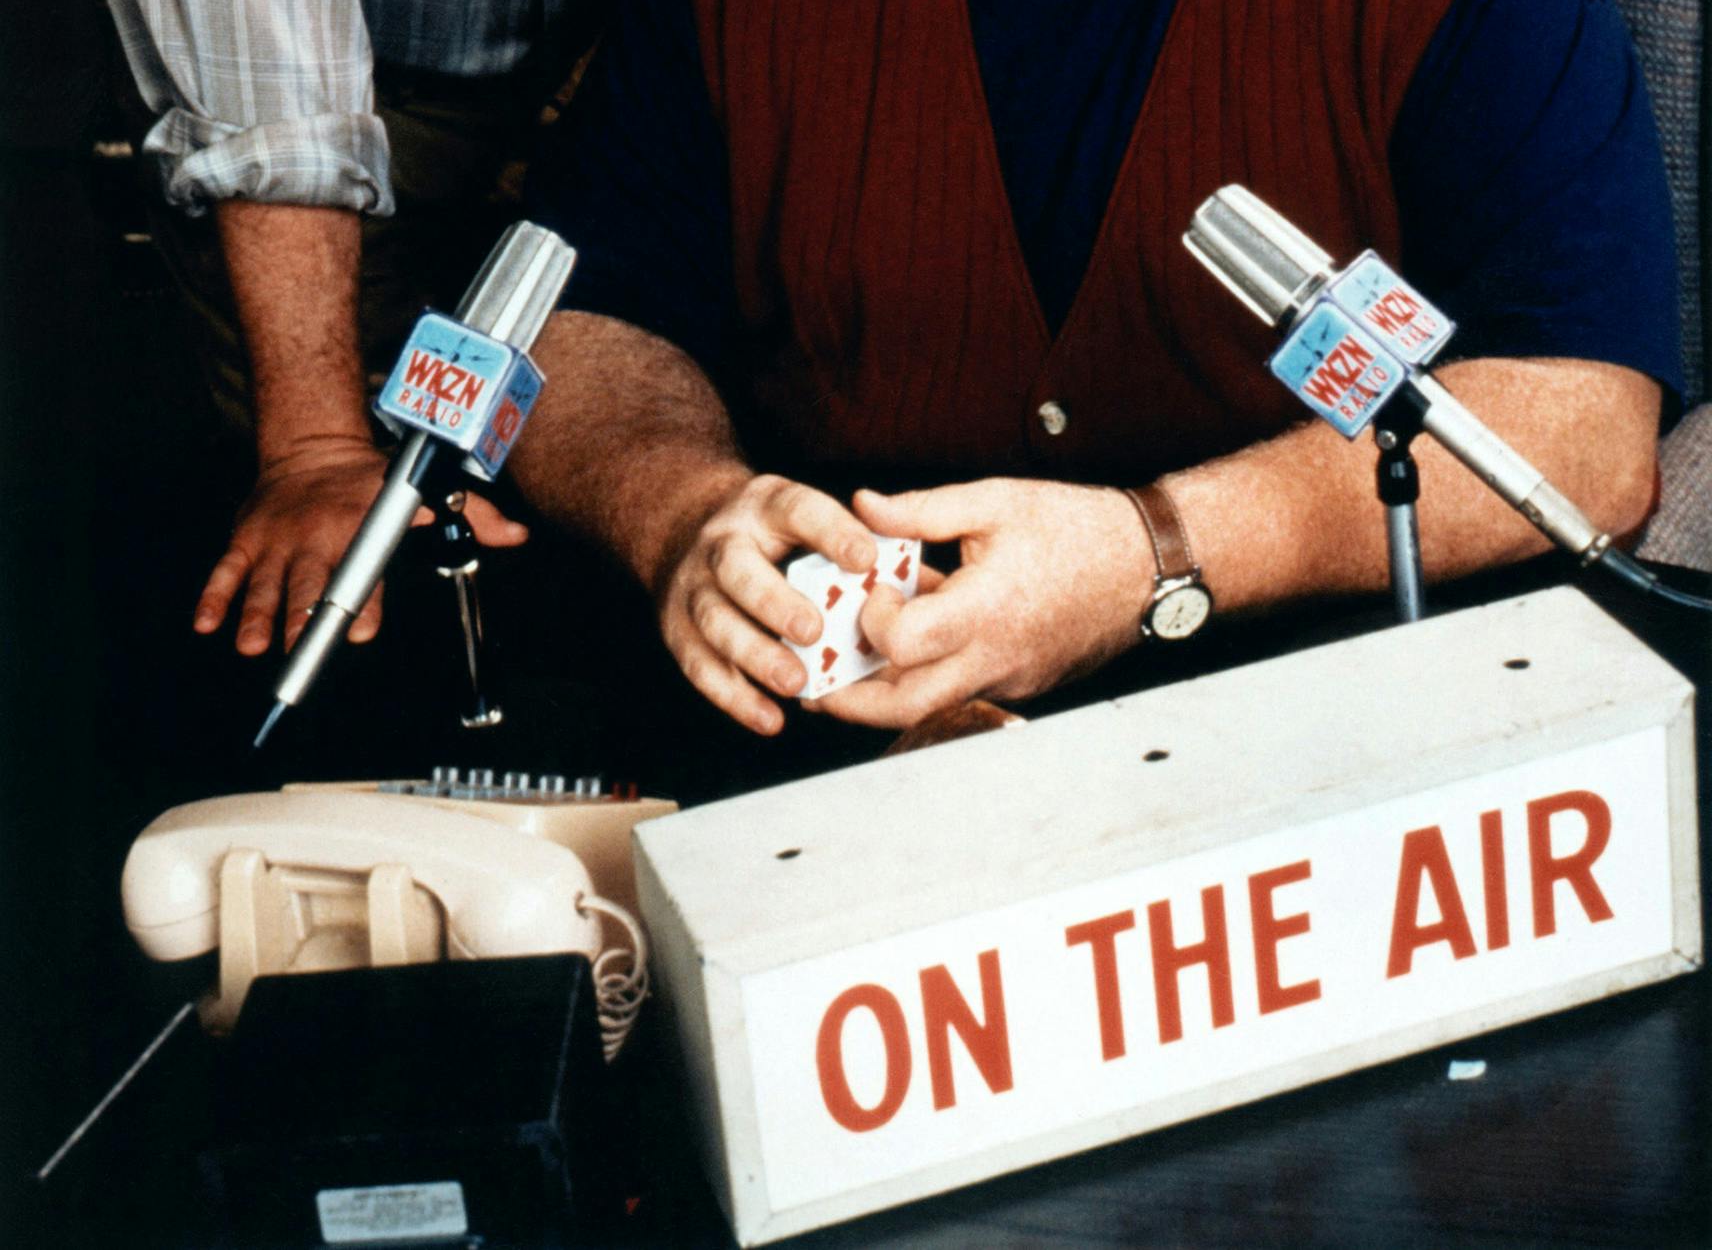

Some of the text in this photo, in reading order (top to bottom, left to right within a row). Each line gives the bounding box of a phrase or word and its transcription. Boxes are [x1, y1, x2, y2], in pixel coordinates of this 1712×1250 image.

[404, 350, 486, 411] WKZN
[1303, 334, 1375, 408] WKZN
[815, 790, 1614, 1134] ON THE AIR
